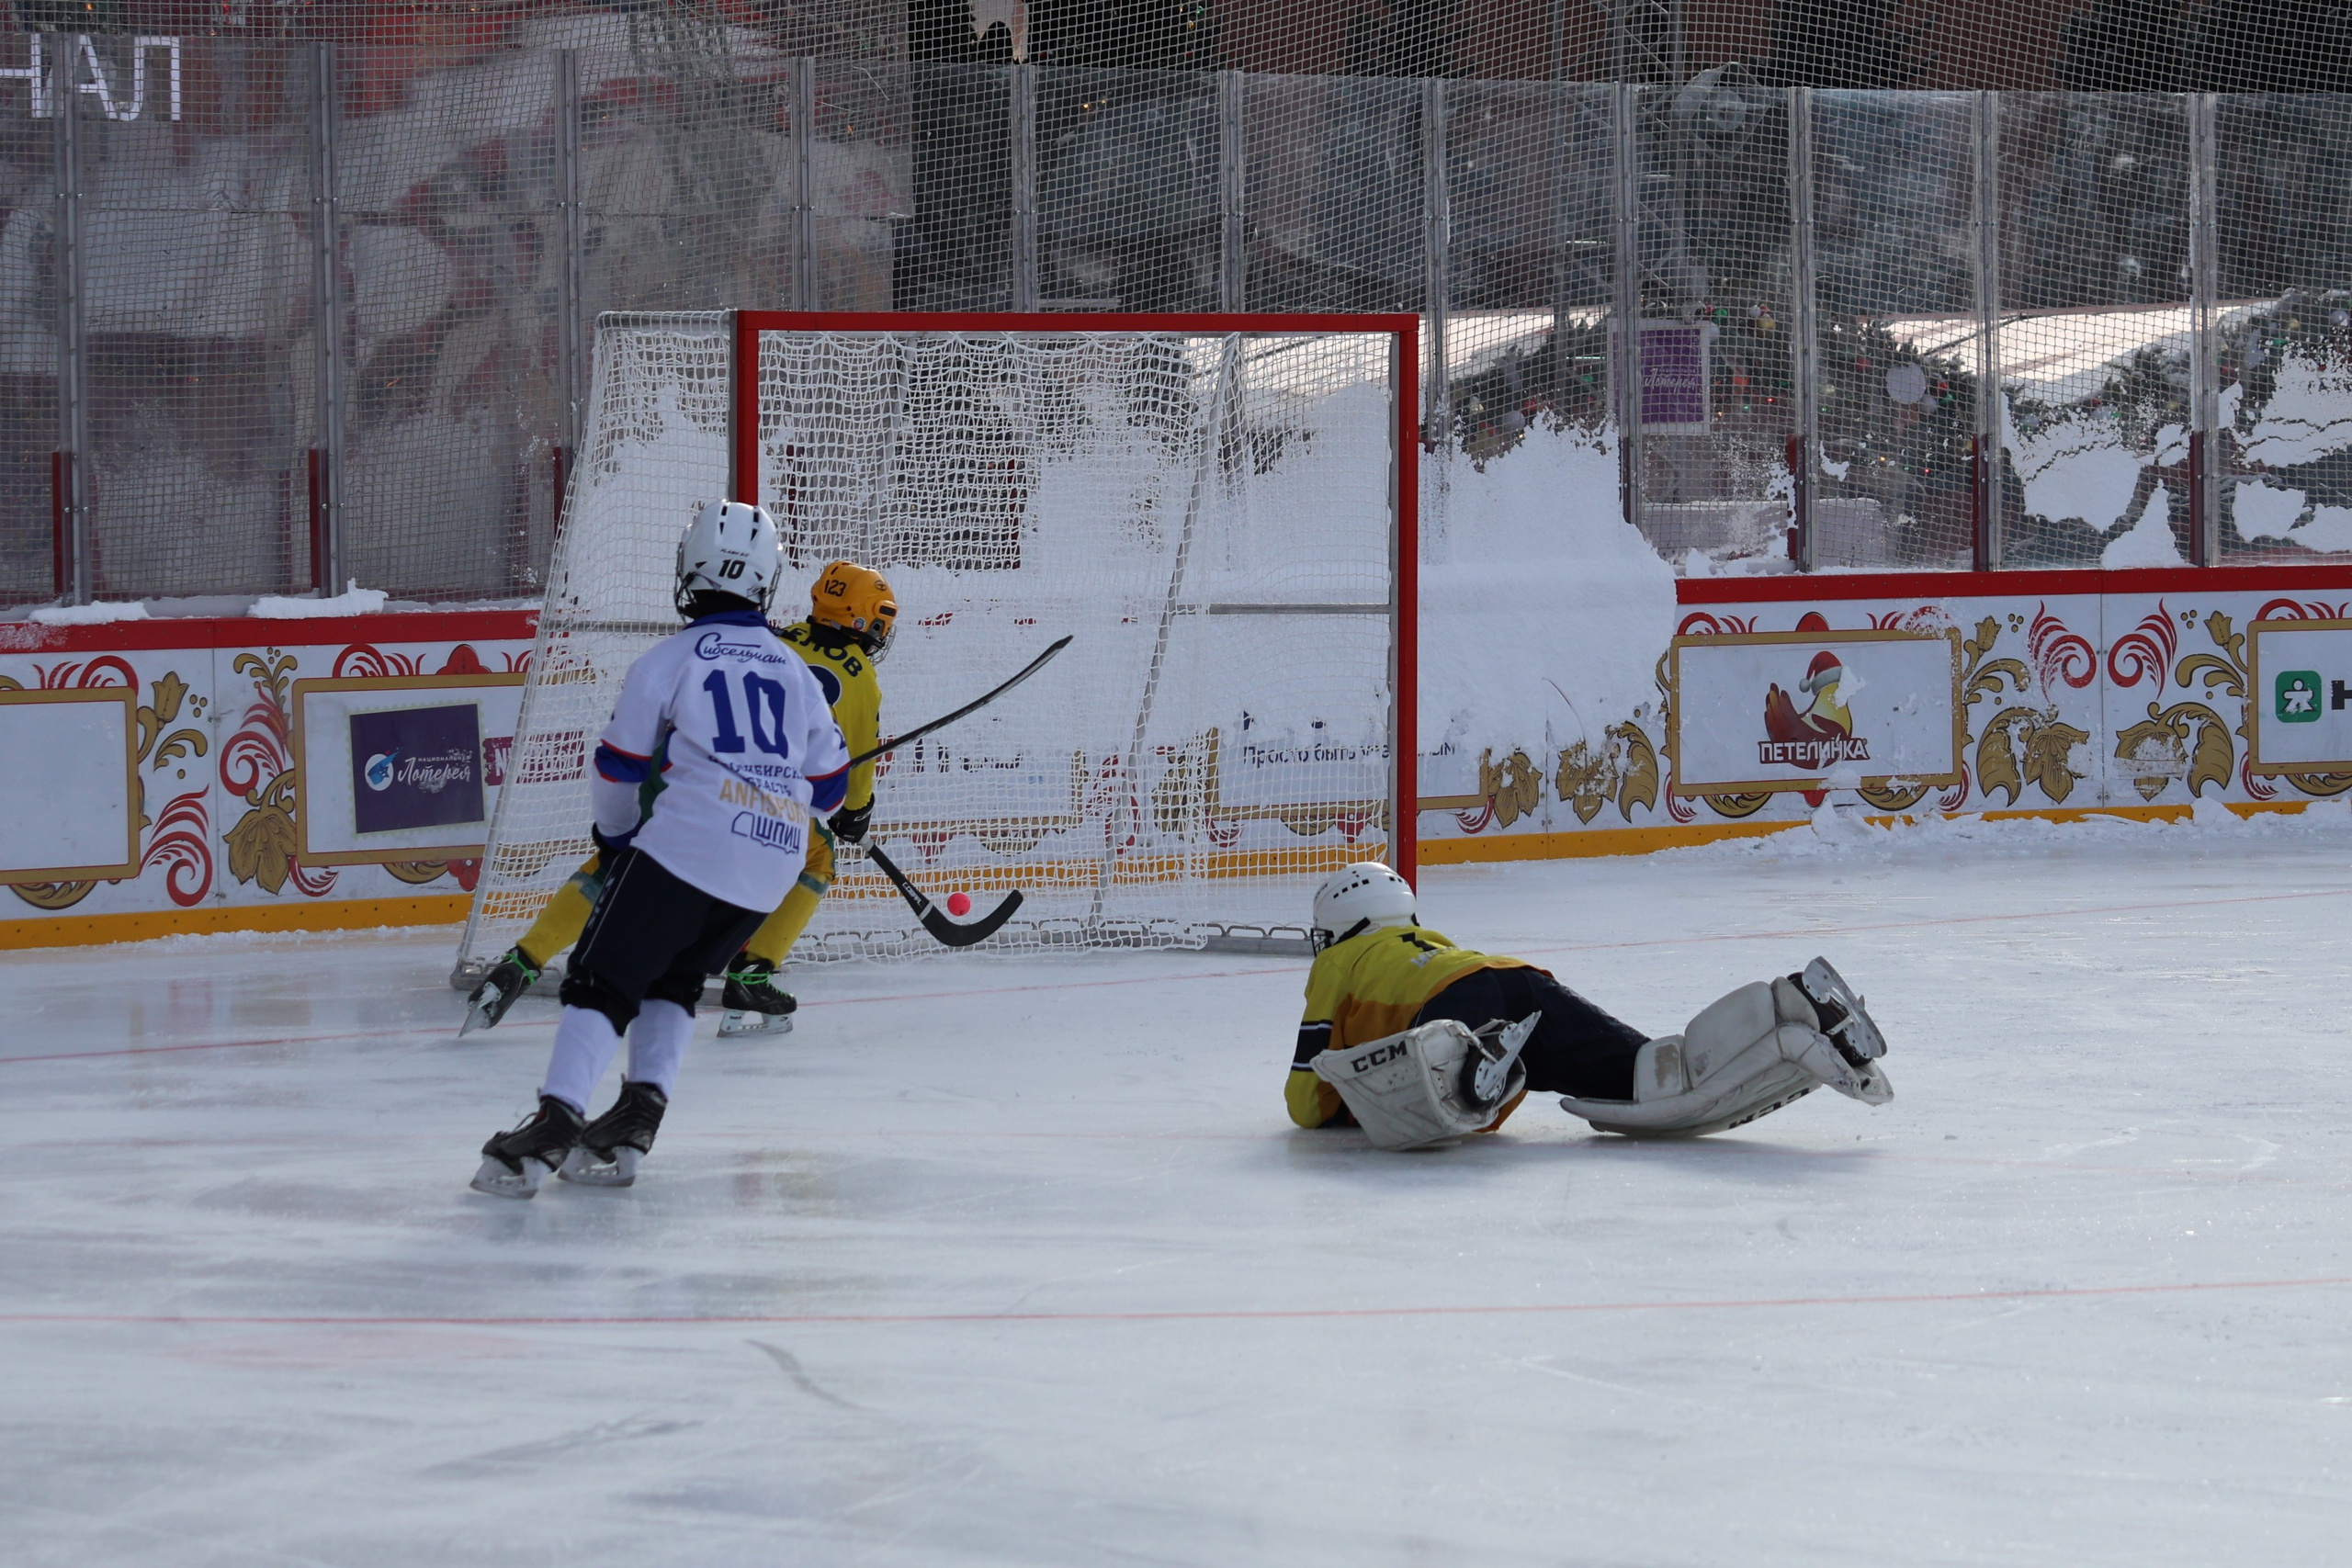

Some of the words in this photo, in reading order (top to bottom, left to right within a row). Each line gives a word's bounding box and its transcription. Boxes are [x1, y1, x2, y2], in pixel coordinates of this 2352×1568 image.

[718, 558, 745, 580] 10
[703, 669, 788, 760] 10
[1243, 746, 1308, 769] Просто
[1314, 742, 1355, 761] быть
[1760, 739, 1869, 761] ПЕТЕЛИНКА
[398, 756, 471, 785] Лотерея
[1351, 1040, 1408, 1074] CCM
